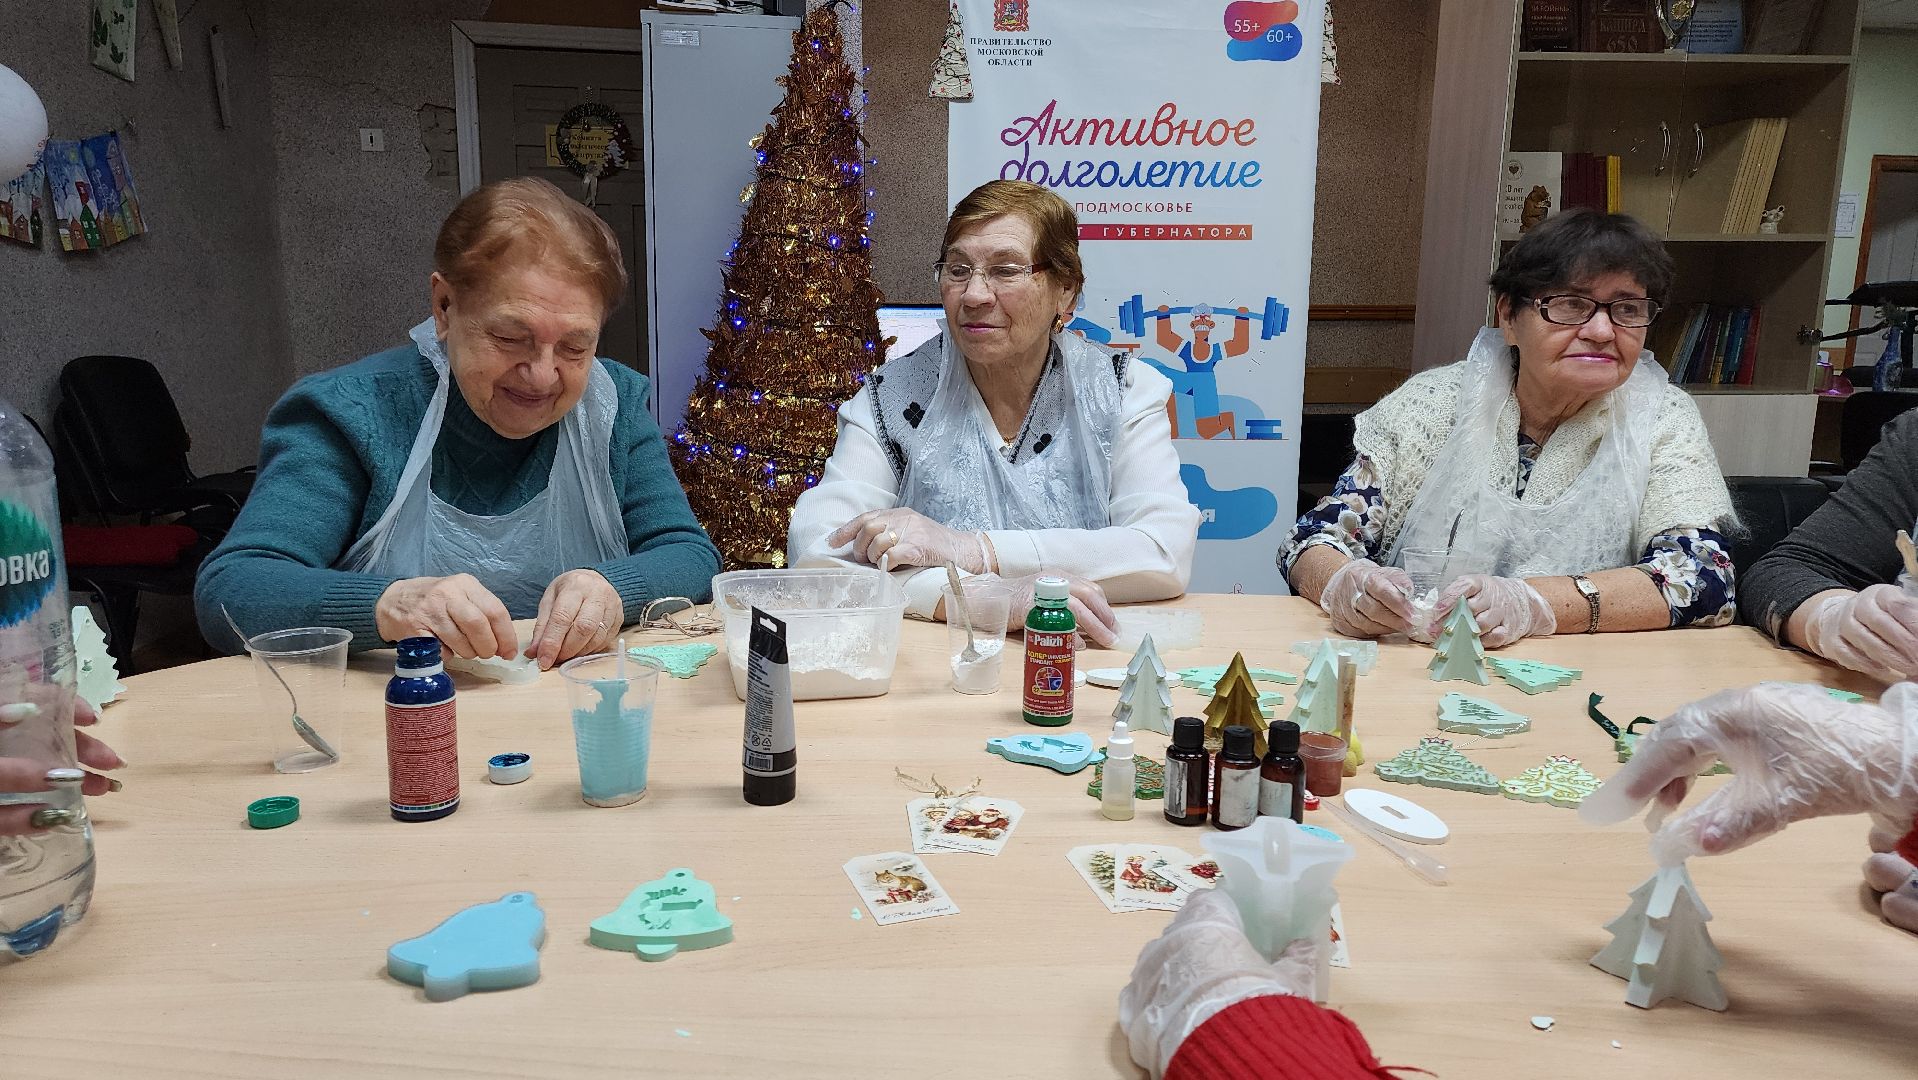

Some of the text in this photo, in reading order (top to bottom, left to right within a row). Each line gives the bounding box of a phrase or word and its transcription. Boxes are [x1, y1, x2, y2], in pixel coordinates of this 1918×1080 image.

[1234, 19, 1261, 33] 55+
[970, 37, 1052, 46] ПРАВИТЕЛЬСТВО
[1266, 29, 1294, 43] 60+
[977, 48, 1044, 56] МОСКОВСКОЙ
[987, 58, 1032, 66] ОБЛАСТИ
[1000, 98, 1258, 147] Активное
[1075, 202, 1193, 214] ПОДМОСКОВЬЕ
[1103, 227, 1247, 237] ГУБЕРНАТОРА
[1034, 634, 1064, 647] Palizh
